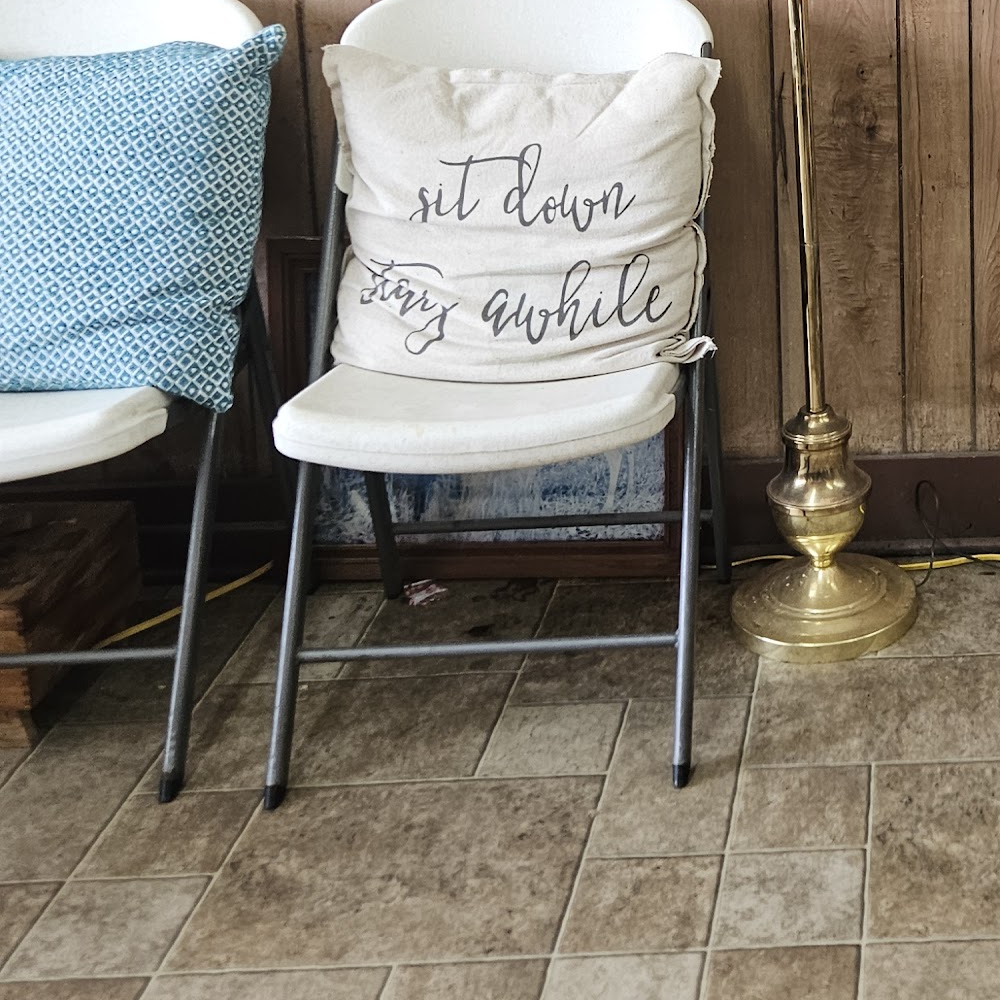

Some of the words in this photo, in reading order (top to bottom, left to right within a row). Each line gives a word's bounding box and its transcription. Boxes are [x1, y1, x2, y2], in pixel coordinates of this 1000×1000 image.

[410, 156, 518, 222] sit
[503, 143, 636, 232] down
[481, 253, 673, 345] awhile
